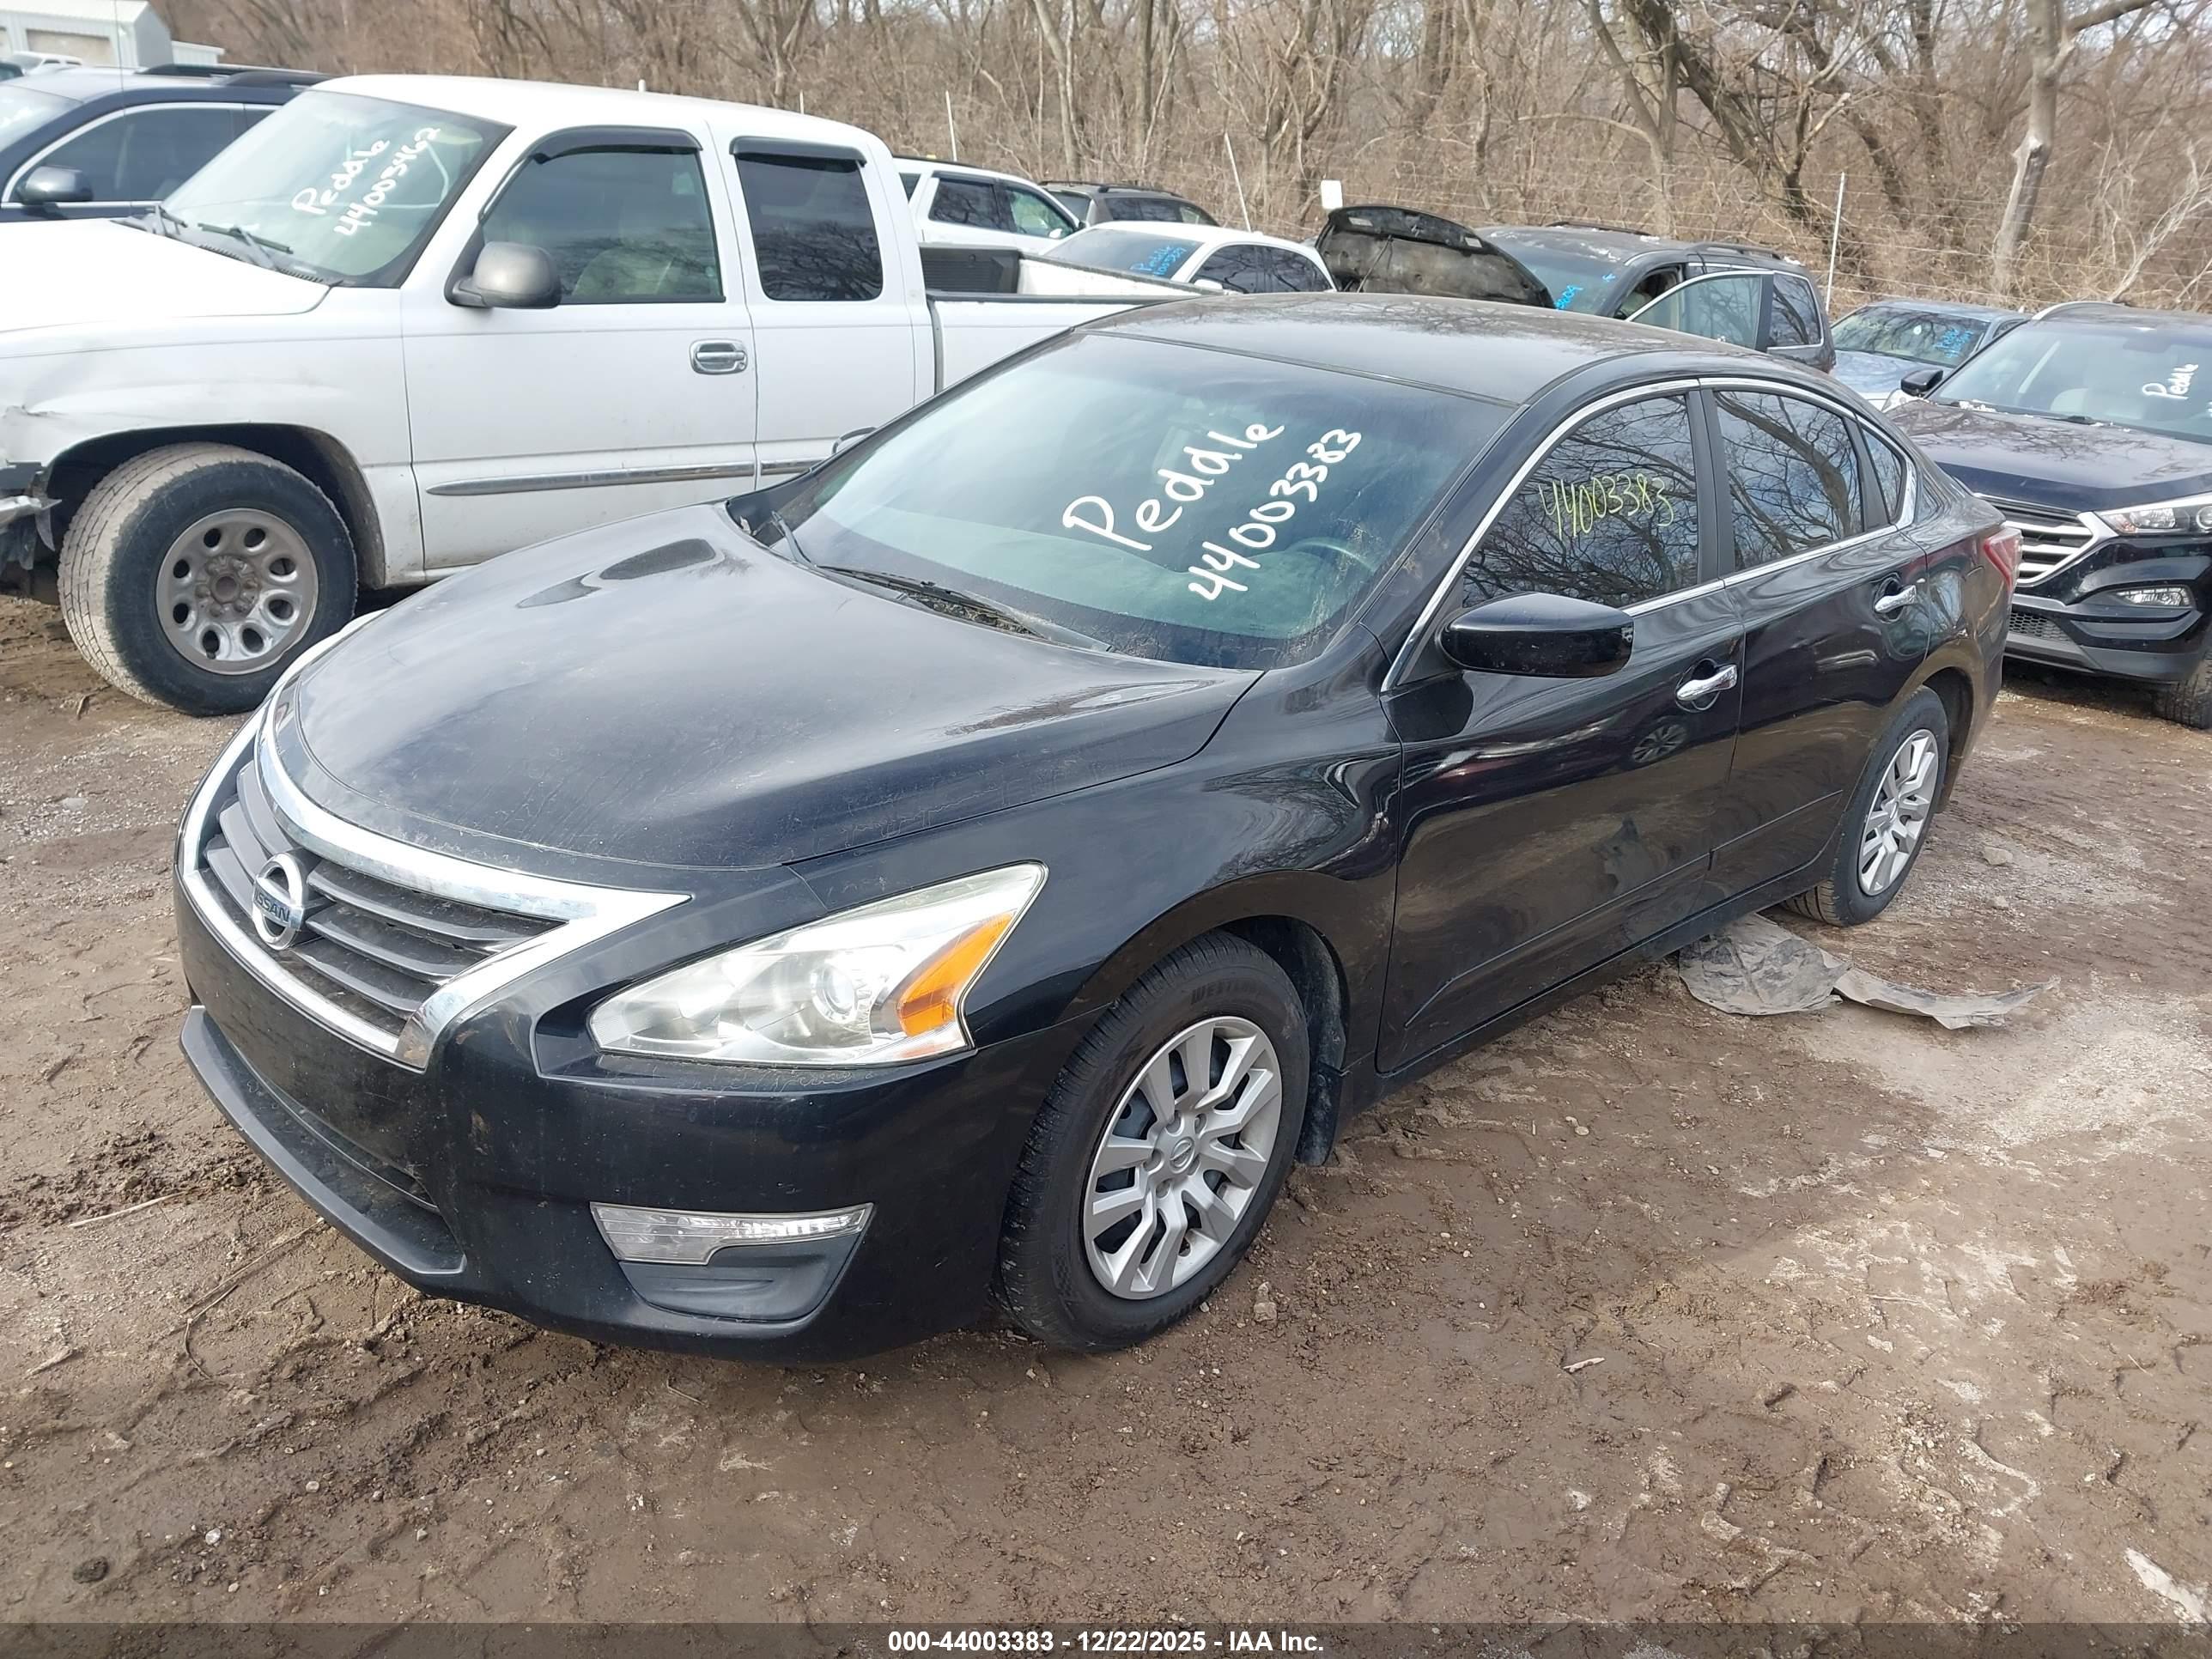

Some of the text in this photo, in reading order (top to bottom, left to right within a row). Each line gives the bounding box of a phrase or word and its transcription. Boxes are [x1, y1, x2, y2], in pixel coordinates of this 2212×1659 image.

[291, 139, 391, 215] Peddle
[1062, 422, 1285, 551] Peddle
[1188, 428, 1362, 601] 44003383
[1538, 473, 1674, 542] 44003383
